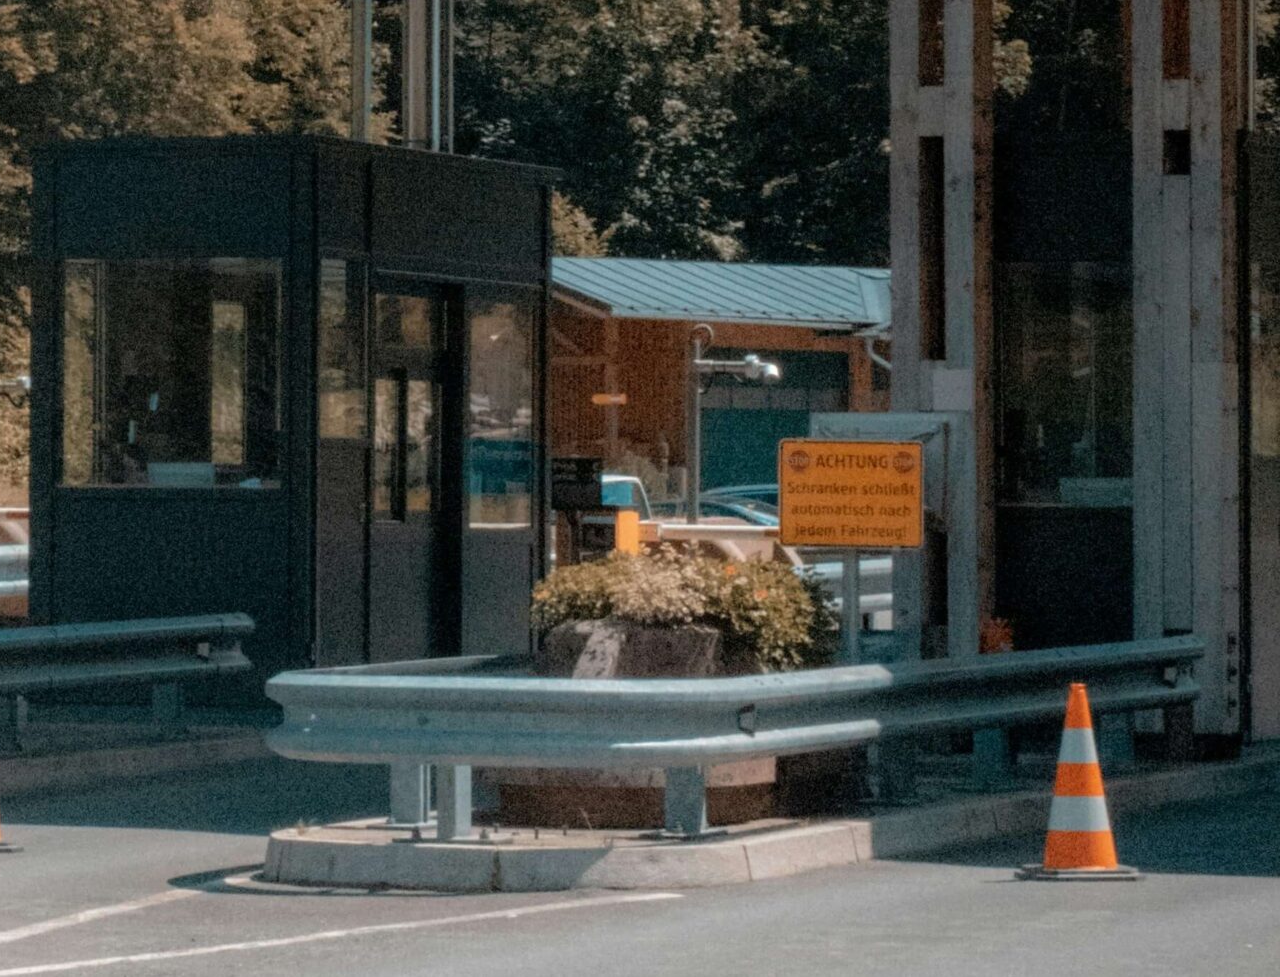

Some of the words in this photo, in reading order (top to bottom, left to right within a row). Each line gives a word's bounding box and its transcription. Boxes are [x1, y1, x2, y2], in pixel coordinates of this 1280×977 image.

[816, 455, 888, 469] ACHTUNG
[787, 482, 857, 494] Schranken
[860, 483, 914, 495] schließt
[791, 505, 874, 516] automatisch
[880, 505, 912, 516] nach
[795, 524, 836, 538] jedem
[841, 525, 906, 539] Fahrzeug!
